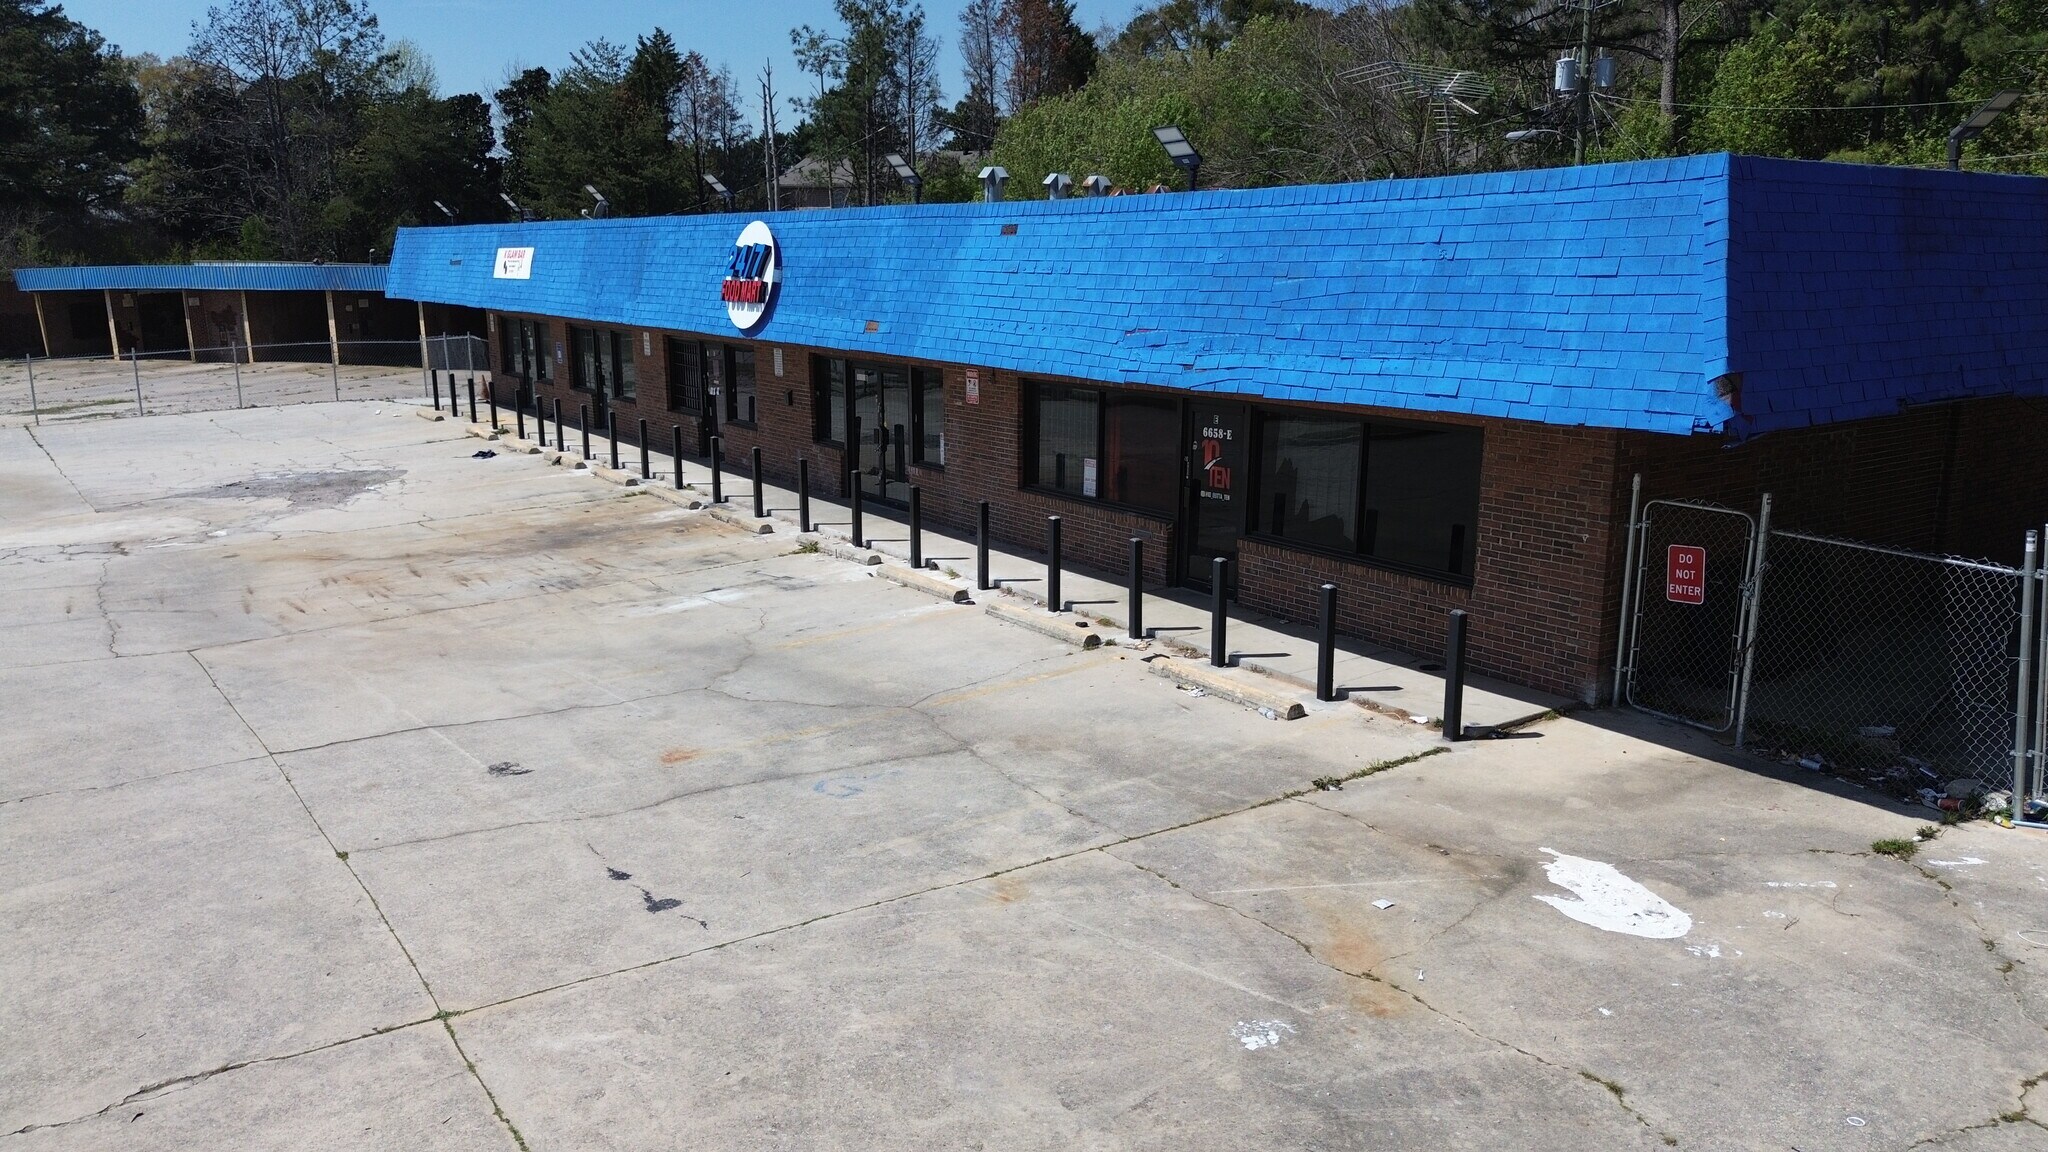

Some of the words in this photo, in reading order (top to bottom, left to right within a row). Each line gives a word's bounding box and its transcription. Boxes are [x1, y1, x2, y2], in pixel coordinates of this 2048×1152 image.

[724, 243, 766, 279] 24/7
[722, 280, 741, 301] FOOD
[740, 280, 762, 303] MART
[1202, 427, 1232, 440] 6658-E
[1209, 465, 1231, 490] TEN
[1679, 553, 1693, 564] DO
[1675, 569, 1696, 580] NOT
[1669, 583, 1701, 597] ENTER
